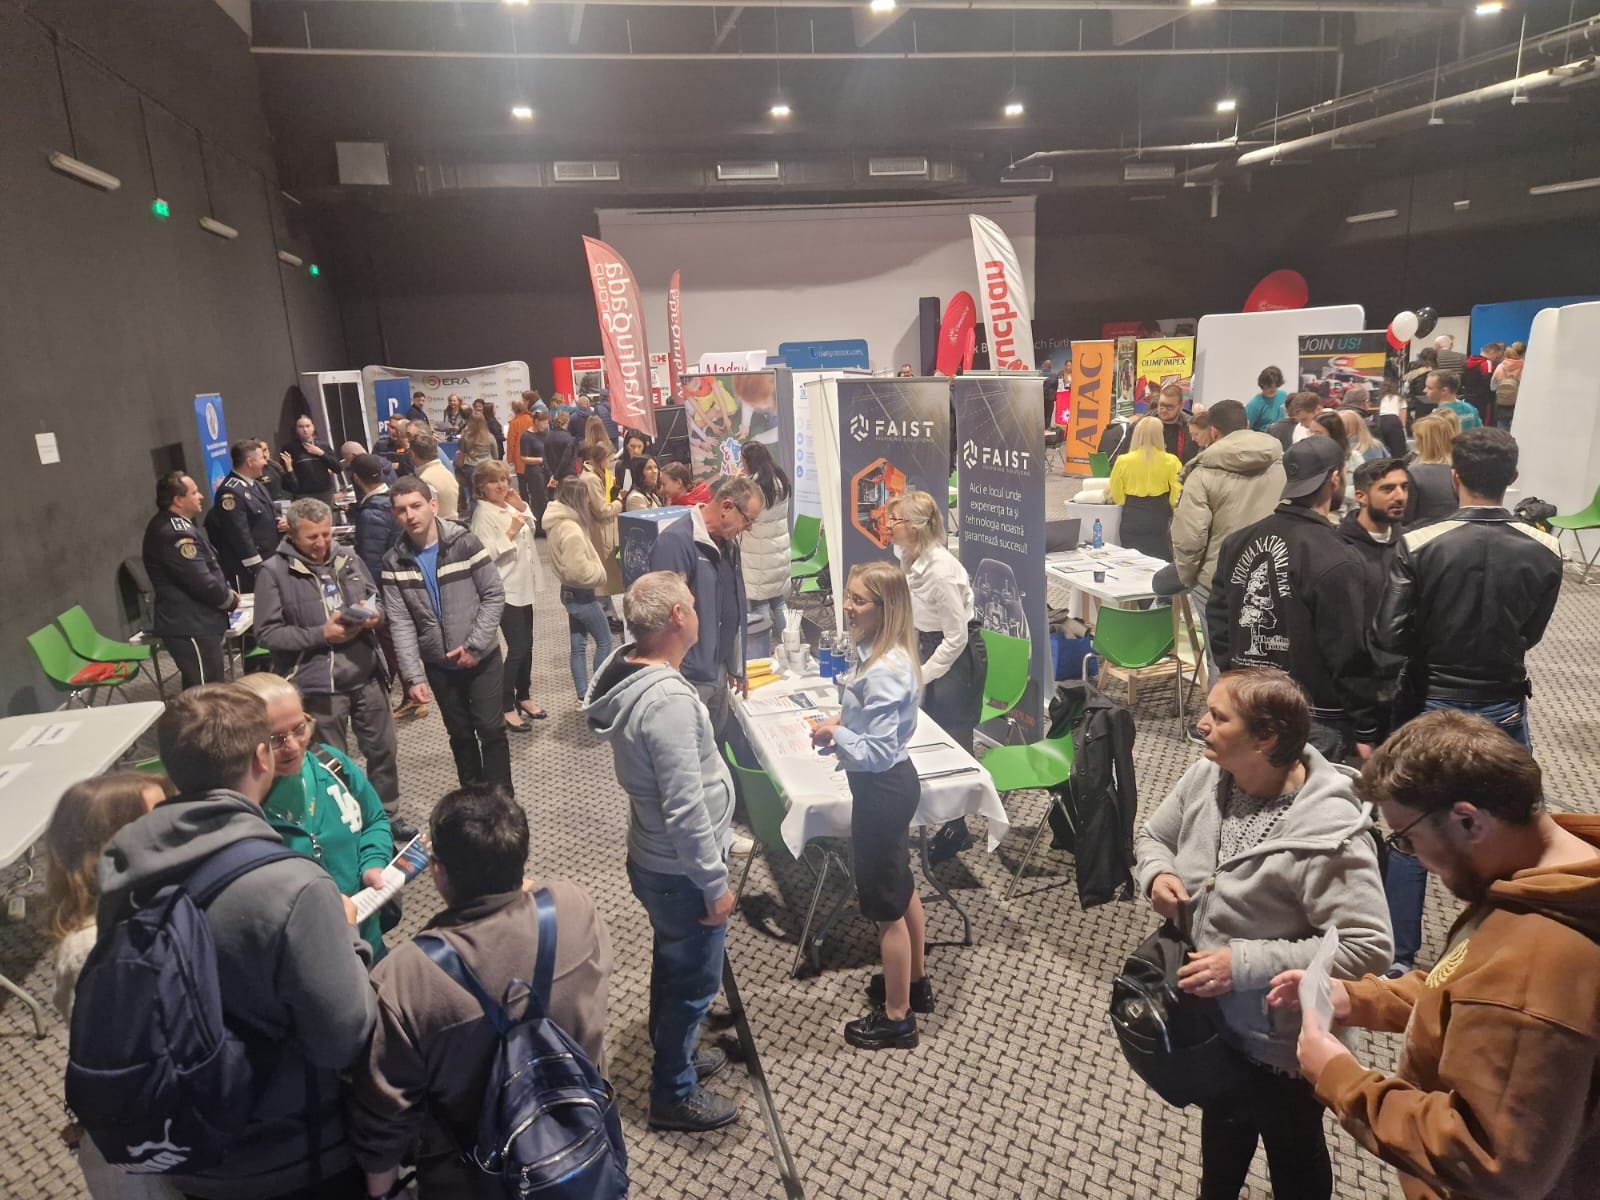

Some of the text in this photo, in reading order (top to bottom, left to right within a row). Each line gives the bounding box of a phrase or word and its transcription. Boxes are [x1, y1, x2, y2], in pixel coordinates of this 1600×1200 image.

[1301, 337, 1362, 351] JOIN US!
[1142, 358, 1186, 367] OLIMP IMPEX
[442, 377, 470, 386] ERA
[1075, 352, 1103, 449] ATAC
[875, 420, 934, 437] FAIST
[983, 447, 1030, 470] FAIST
[969, 482, 1022, 502] Aici e locul unde
[1006, 505, 1014, 516] ta
[965, 514, 1025, 537] tehnologia noastră
[964, 530, 1028, 554] garantează succesul!
[1231, 535, 1294, 599] SEQUOIA NATIONAL PARK
